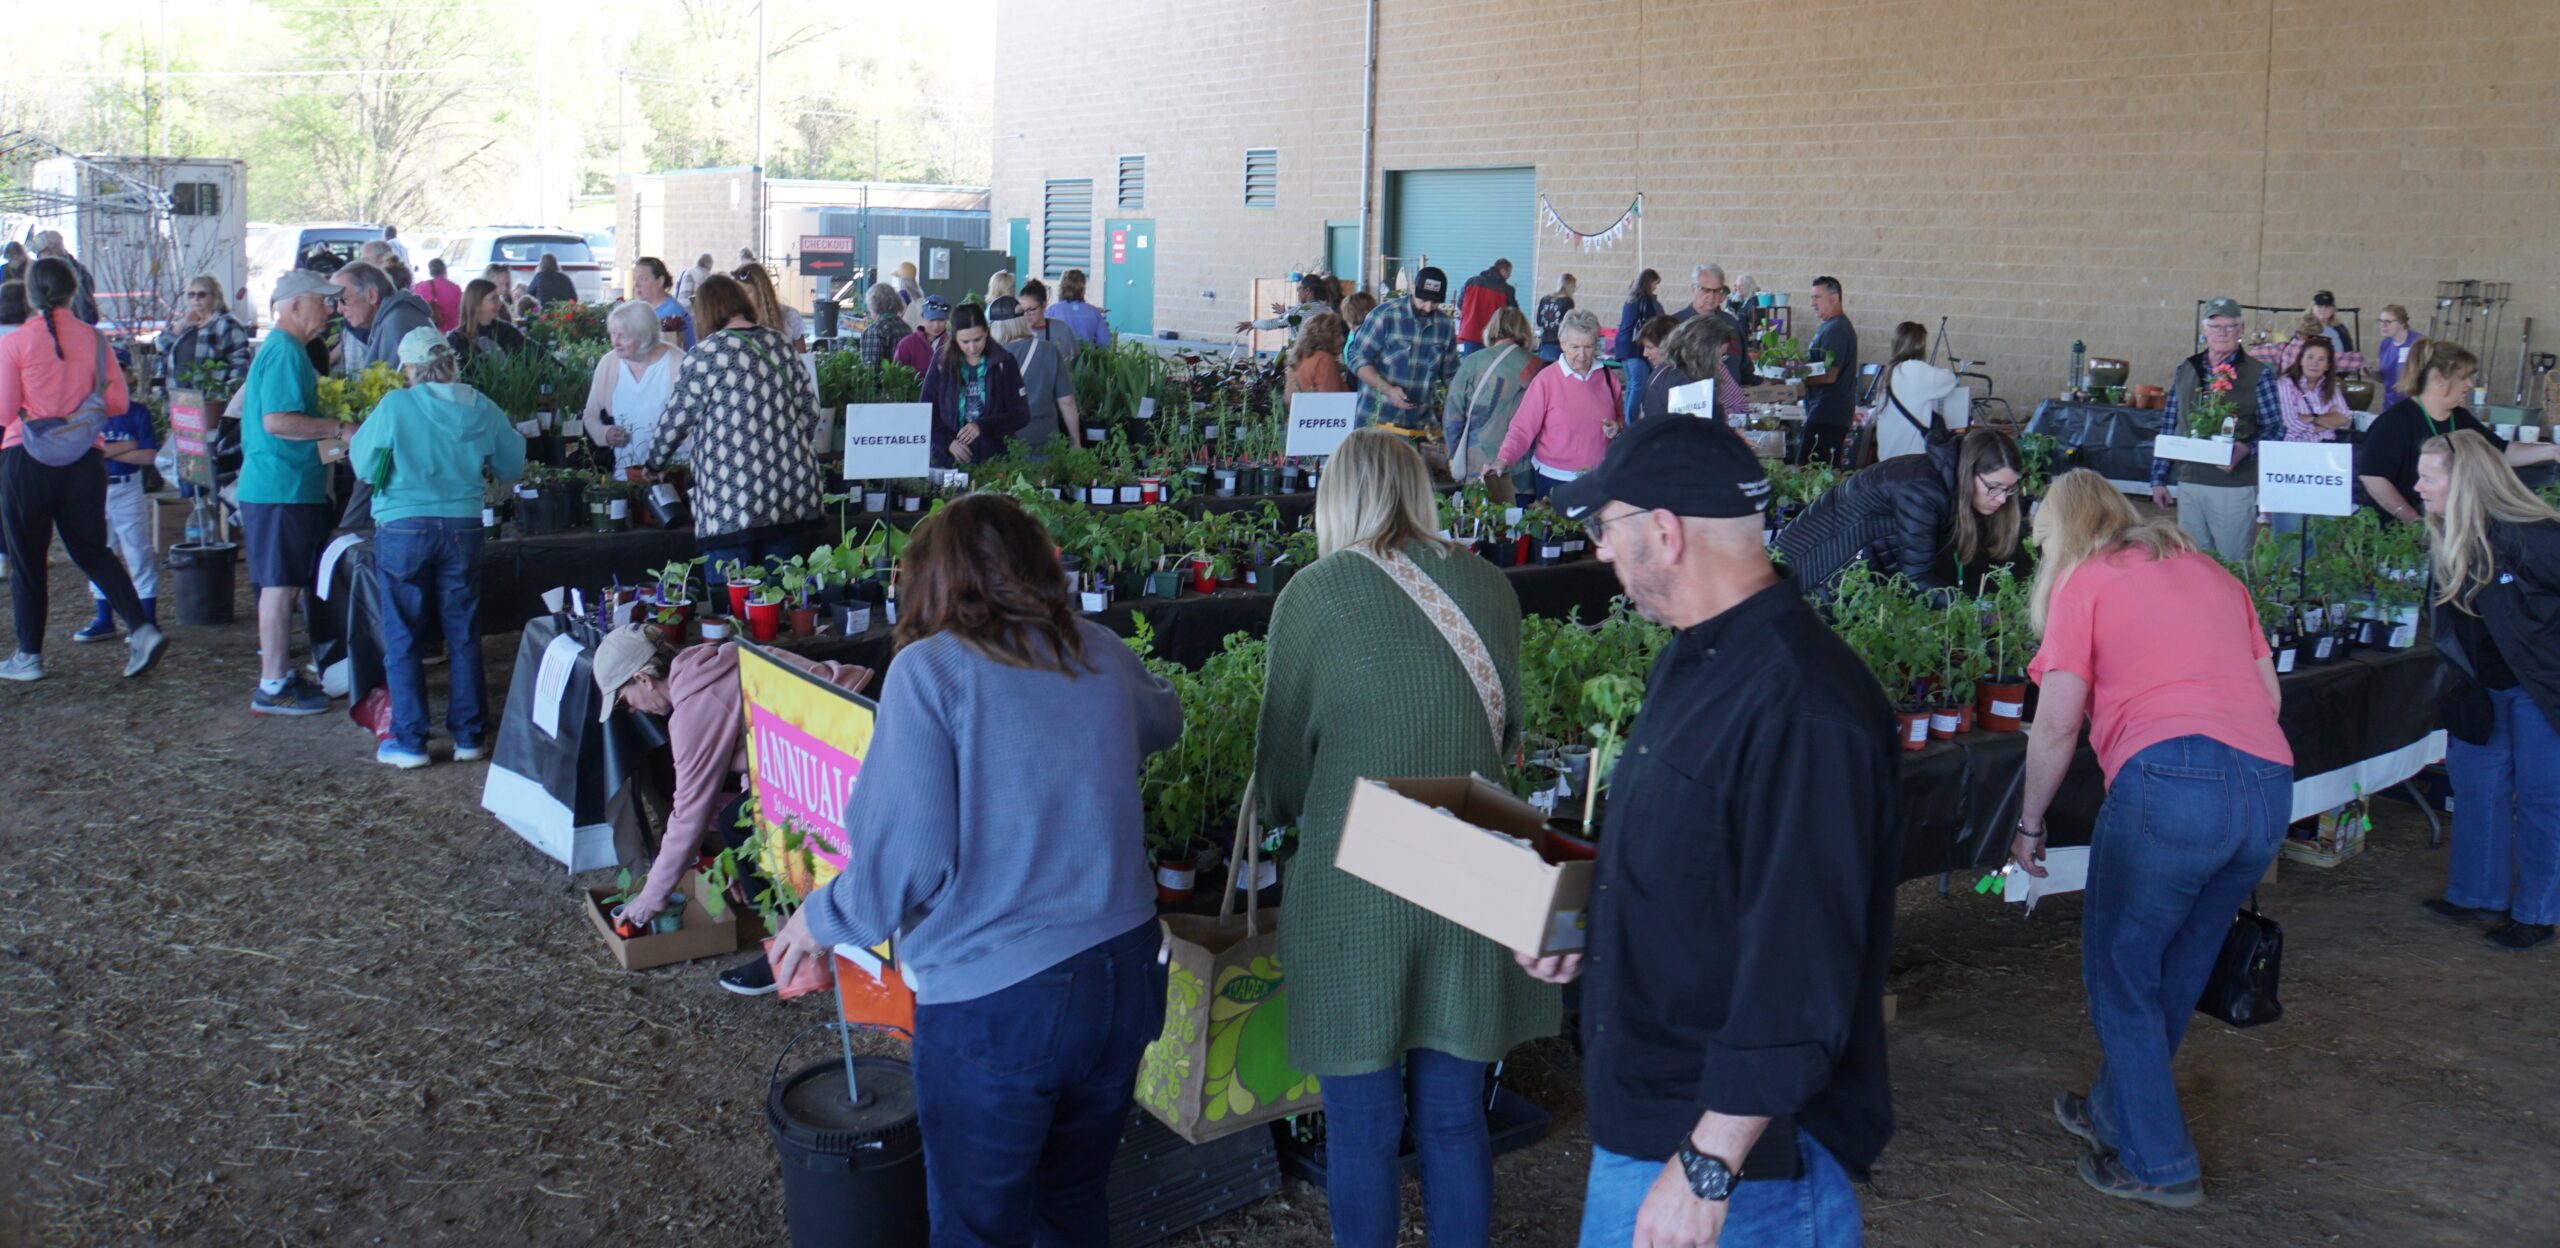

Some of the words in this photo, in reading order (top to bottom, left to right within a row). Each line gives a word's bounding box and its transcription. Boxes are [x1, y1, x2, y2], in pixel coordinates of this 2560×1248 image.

[804, 239, 850, 249] CHECKOUT
[1298, 418, 1348, 429] PEPPERS
[852, 434, 927, 446] VEGETABLES
[2265, 472, 2344, 486] TOMATOES
